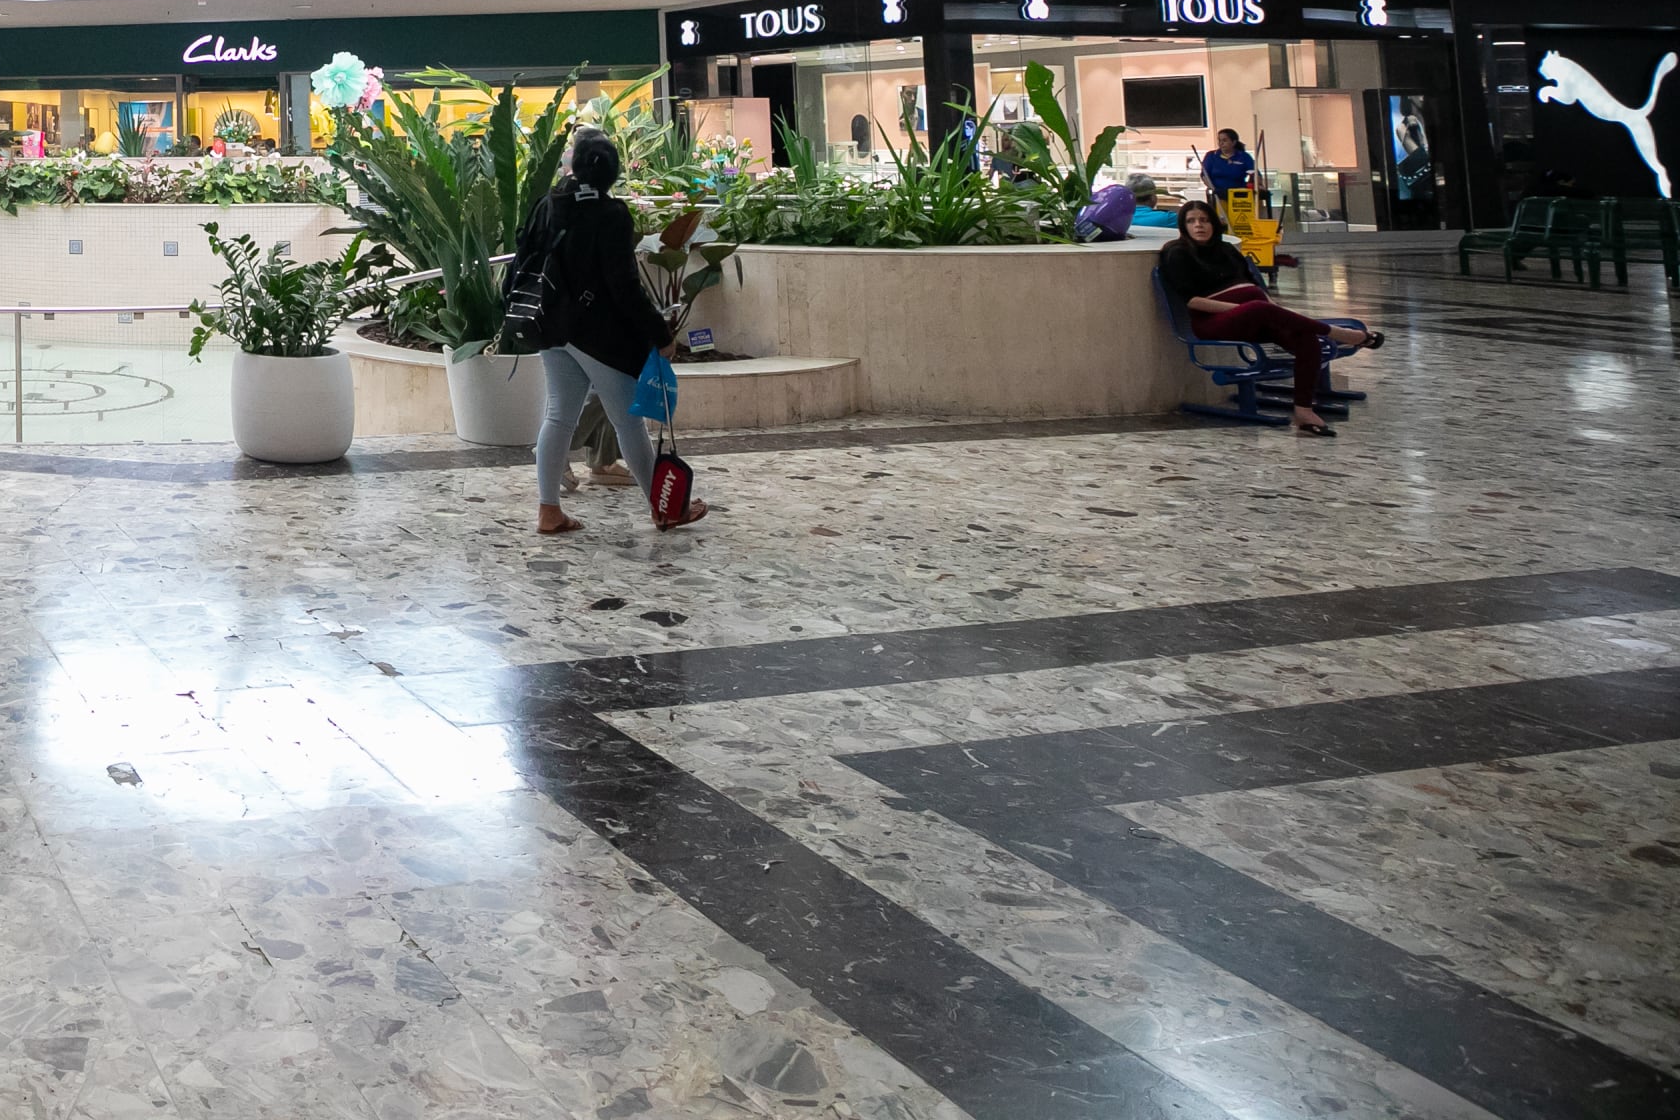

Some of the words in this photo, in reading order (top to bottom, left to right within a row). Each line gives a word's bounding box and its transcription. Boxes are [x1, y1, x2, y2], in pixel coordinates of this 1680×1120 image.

[740, 4, 825, 39] TOUS
[182, 34, 277, 63] Clarks
[659, 469, 676, 514] TOMMY
